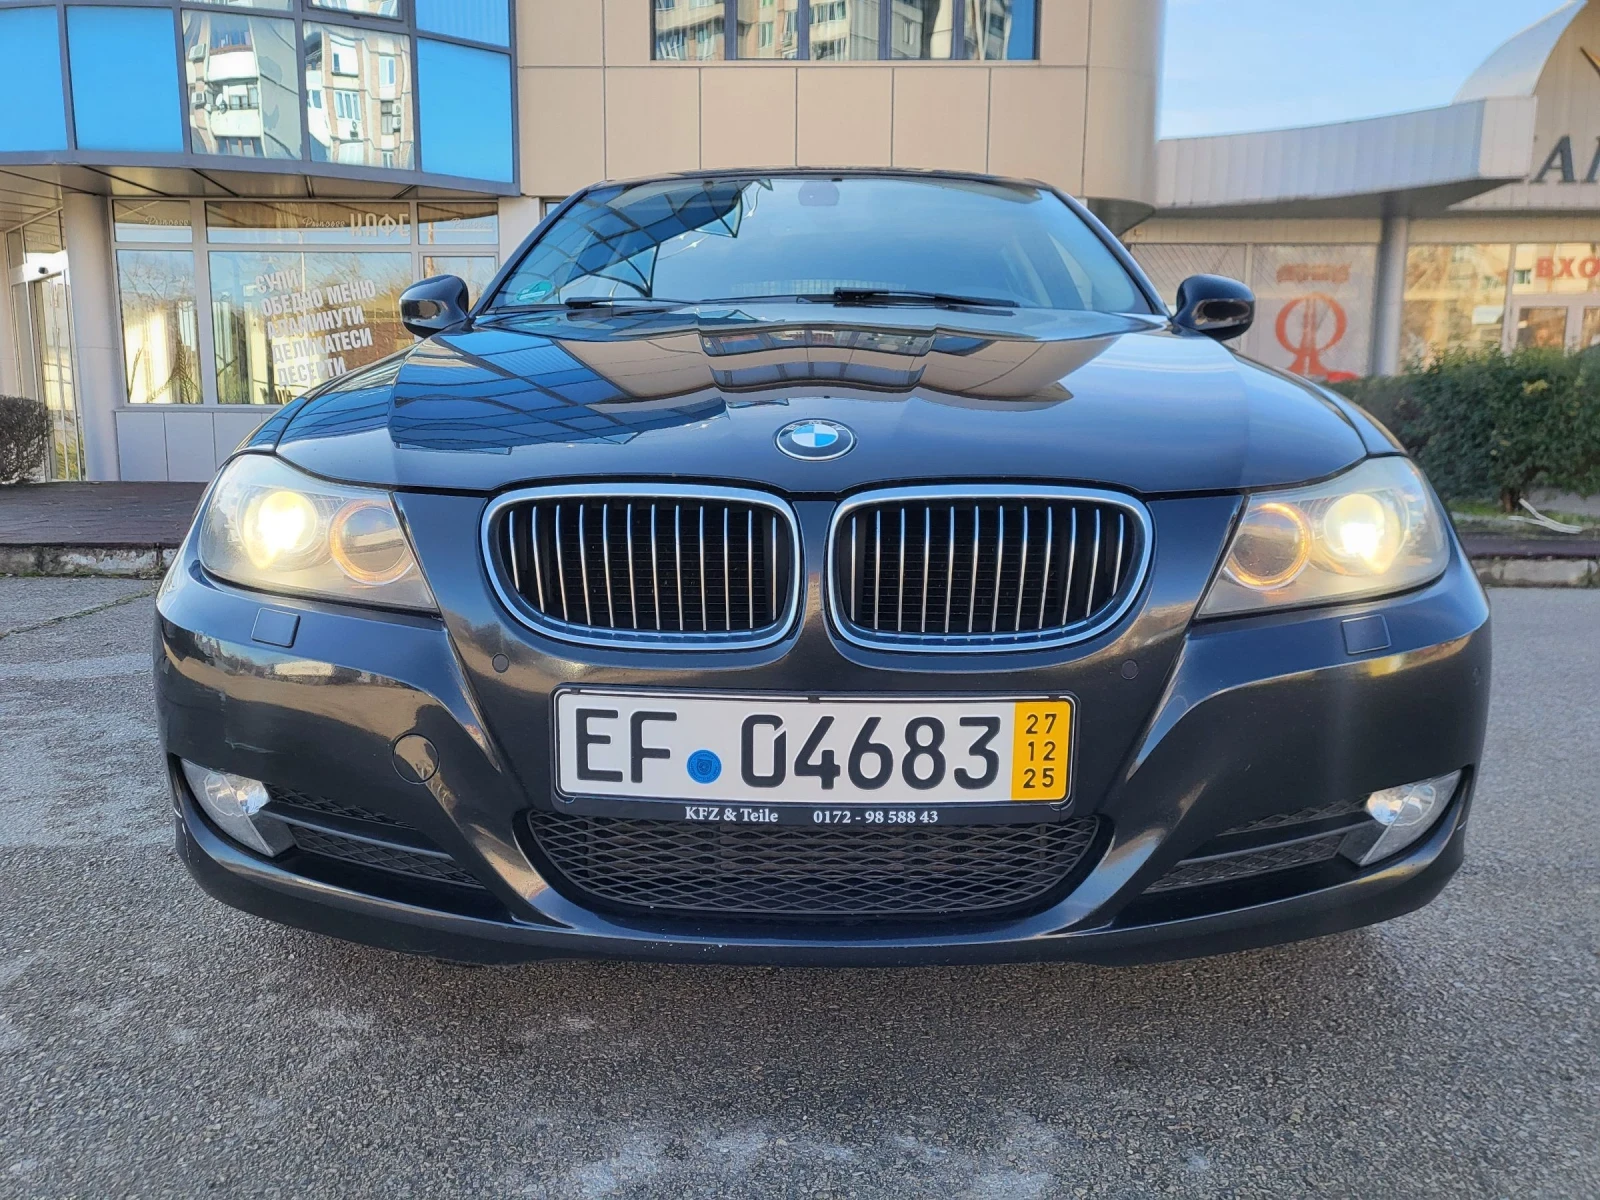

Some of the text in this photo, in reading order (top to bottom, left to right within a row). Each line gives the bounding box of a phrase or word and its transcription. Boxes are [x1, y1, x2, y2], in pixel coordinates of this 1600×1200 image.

[1529, 134, 1600, 183] A
[350, 212, 410, 237] КАФЕ
[255, 269, 300, 294] СУПИ
[261, 279, 376, 317] ОБЕДНО МЕНЮ
[267, 305, 365, 340] АЛАМИНУТИ
[271, 327, 373, 364] ДЕЛИКАТЕСИ
[277, 356, 347, 387] ДЕСЕРТИ
[1025, 713, 1057, 735] 27
[575, 708, 677, 784] EF
[740, 714, 1001, 791] 04683
[1027, 741, 1056, 761] 12
[1023, 767, 1055, 789] 25
[685, 806, 779, 823] KFZ & Teile
[813, 810, 851, 824] 0172
[865, 810, 884, 824] 98
[887, 810, 916, 824] 588
[919, 810, 939, 824] 43
